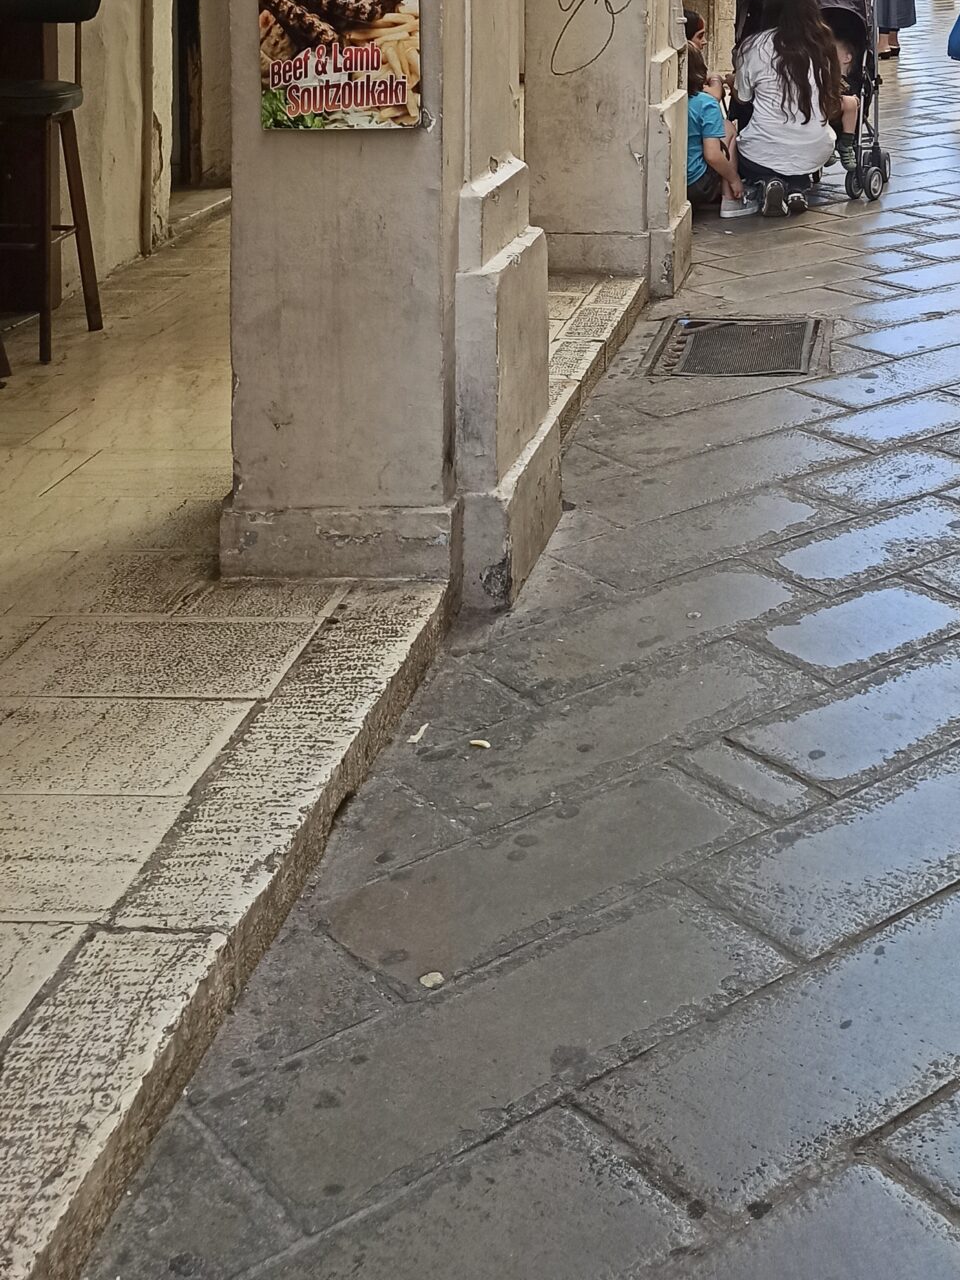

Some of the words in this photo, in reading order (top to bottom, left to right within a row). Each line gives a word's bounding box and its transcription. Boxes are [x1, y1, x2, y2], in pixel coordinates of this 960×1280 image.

[270, 47, 312, 89] Beef
[315, 44, 329, 76] &
[332, 42, 382, 73] Lamb
[286, 74, 408, 118] Soutzoukaki
